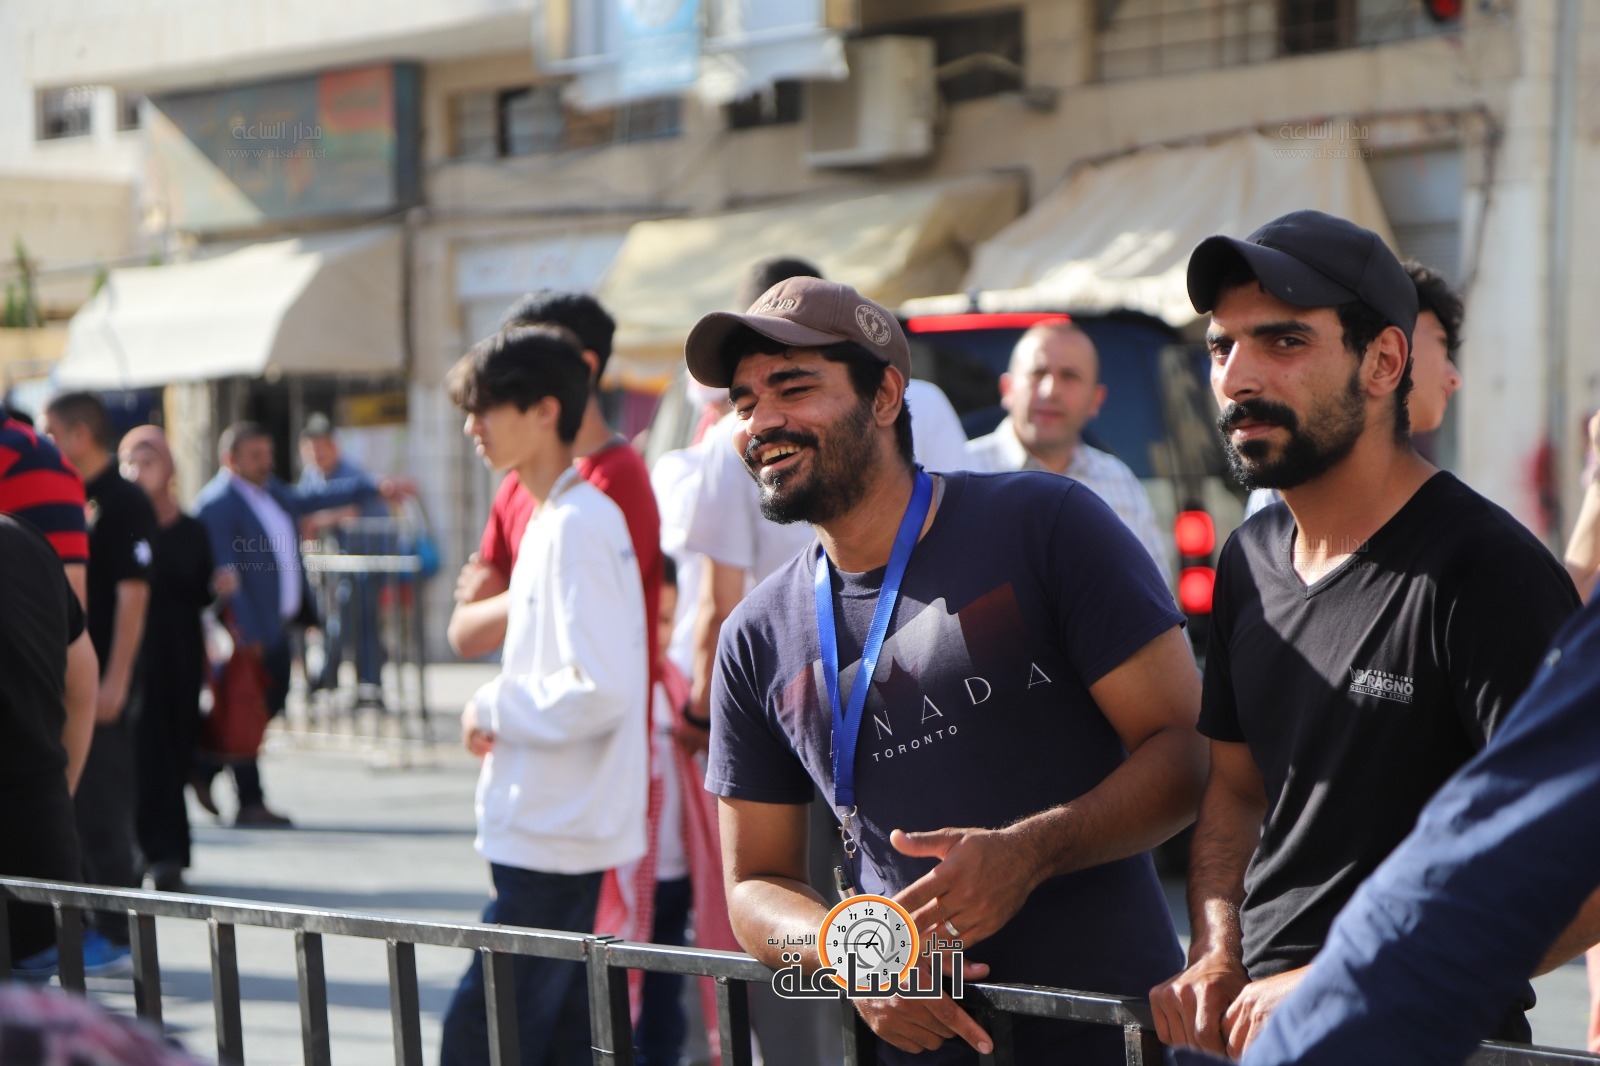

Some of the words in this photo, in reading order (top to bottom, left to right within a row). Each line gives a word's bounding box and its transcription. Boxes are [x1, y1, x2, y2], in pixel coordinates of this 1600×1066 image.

[1366, 674, 1414, 695] RAGNO
[1368, 669, 1414, 684] CERAMICHE
[872, 724, 958, 762] TORONTO
